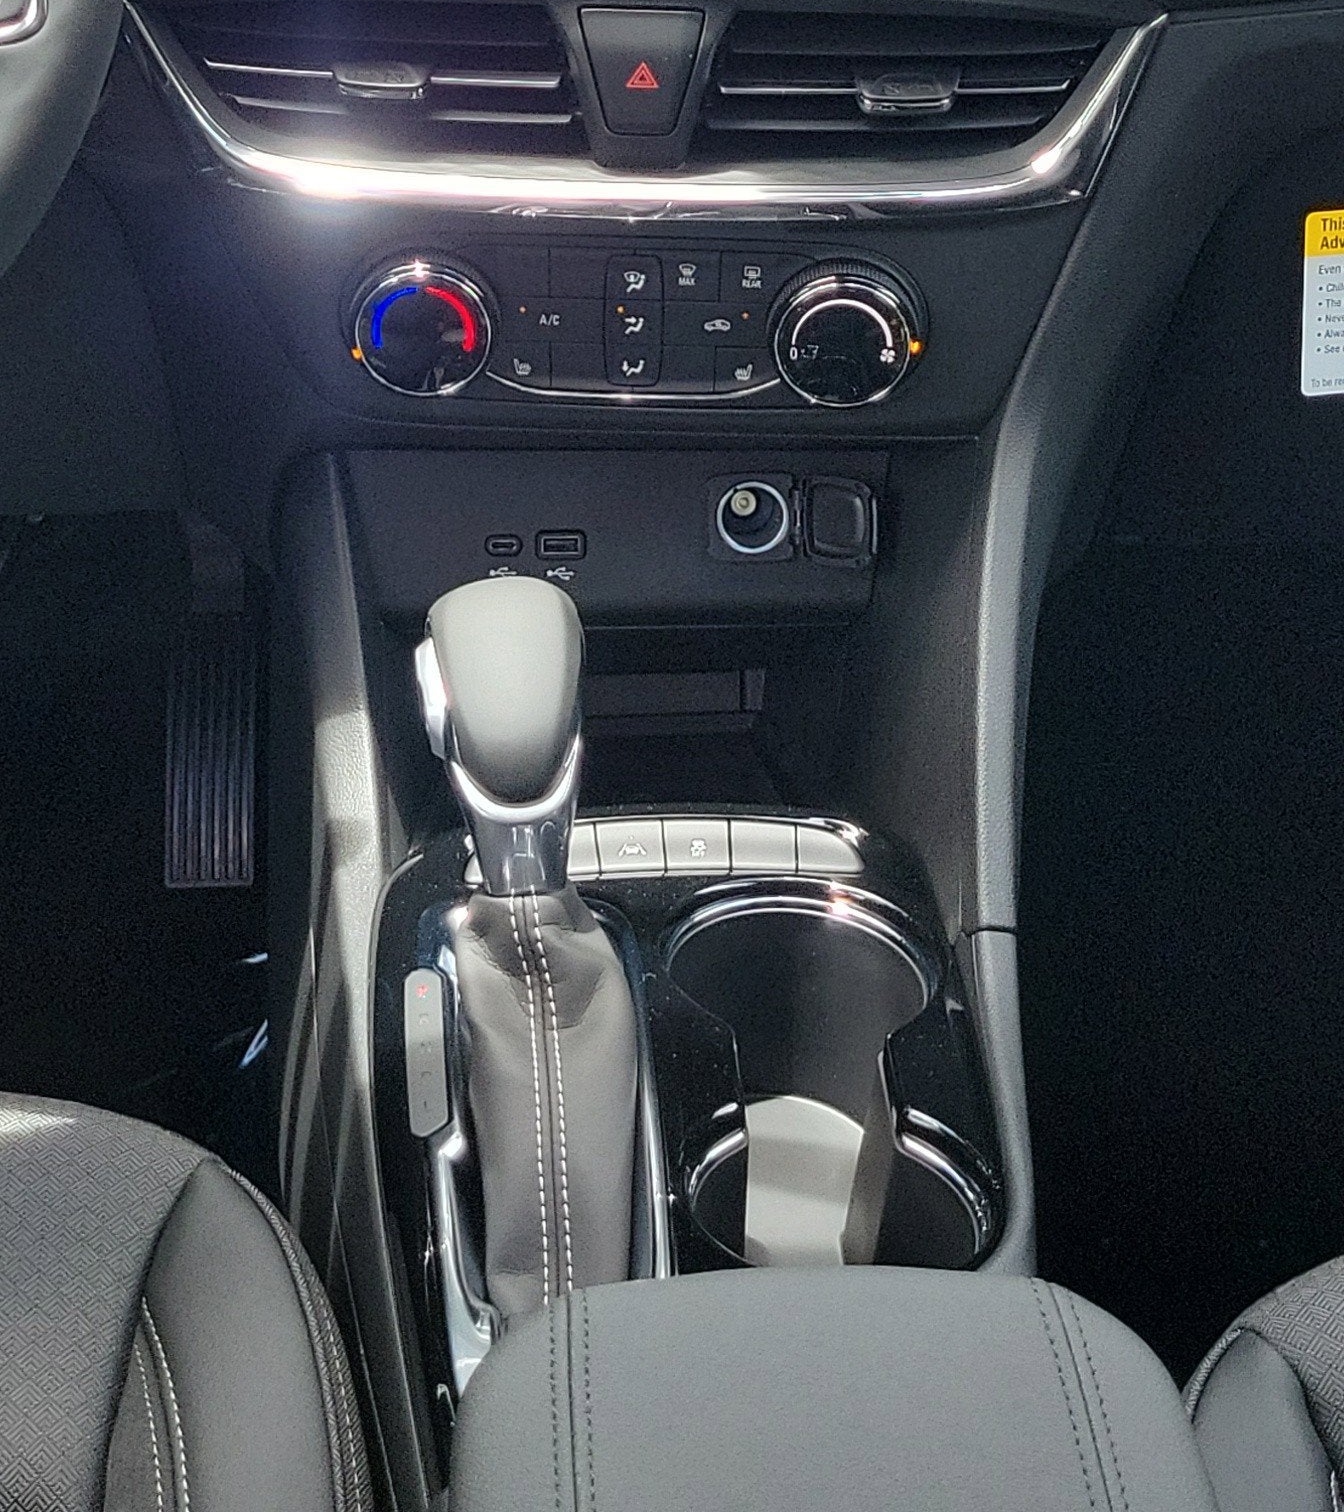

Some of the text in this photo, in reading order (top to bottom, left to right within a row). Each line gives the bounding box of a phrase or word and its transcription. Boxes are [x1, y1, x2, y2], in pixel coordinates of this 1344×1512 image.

[1318, 264, 1341, 275] Even
[678, 276, 696, 287] MAX
[741, 278, 763, 289] REAR
[1325, 298, 1341, 308] The
[538, 313, 561, 326] A/C
[789, 346, 798, 361] 0
[1324, 345, 1340, 354] See
[1310, 378, 1320, 388] To
[1322, 377, 1332, 387] be
